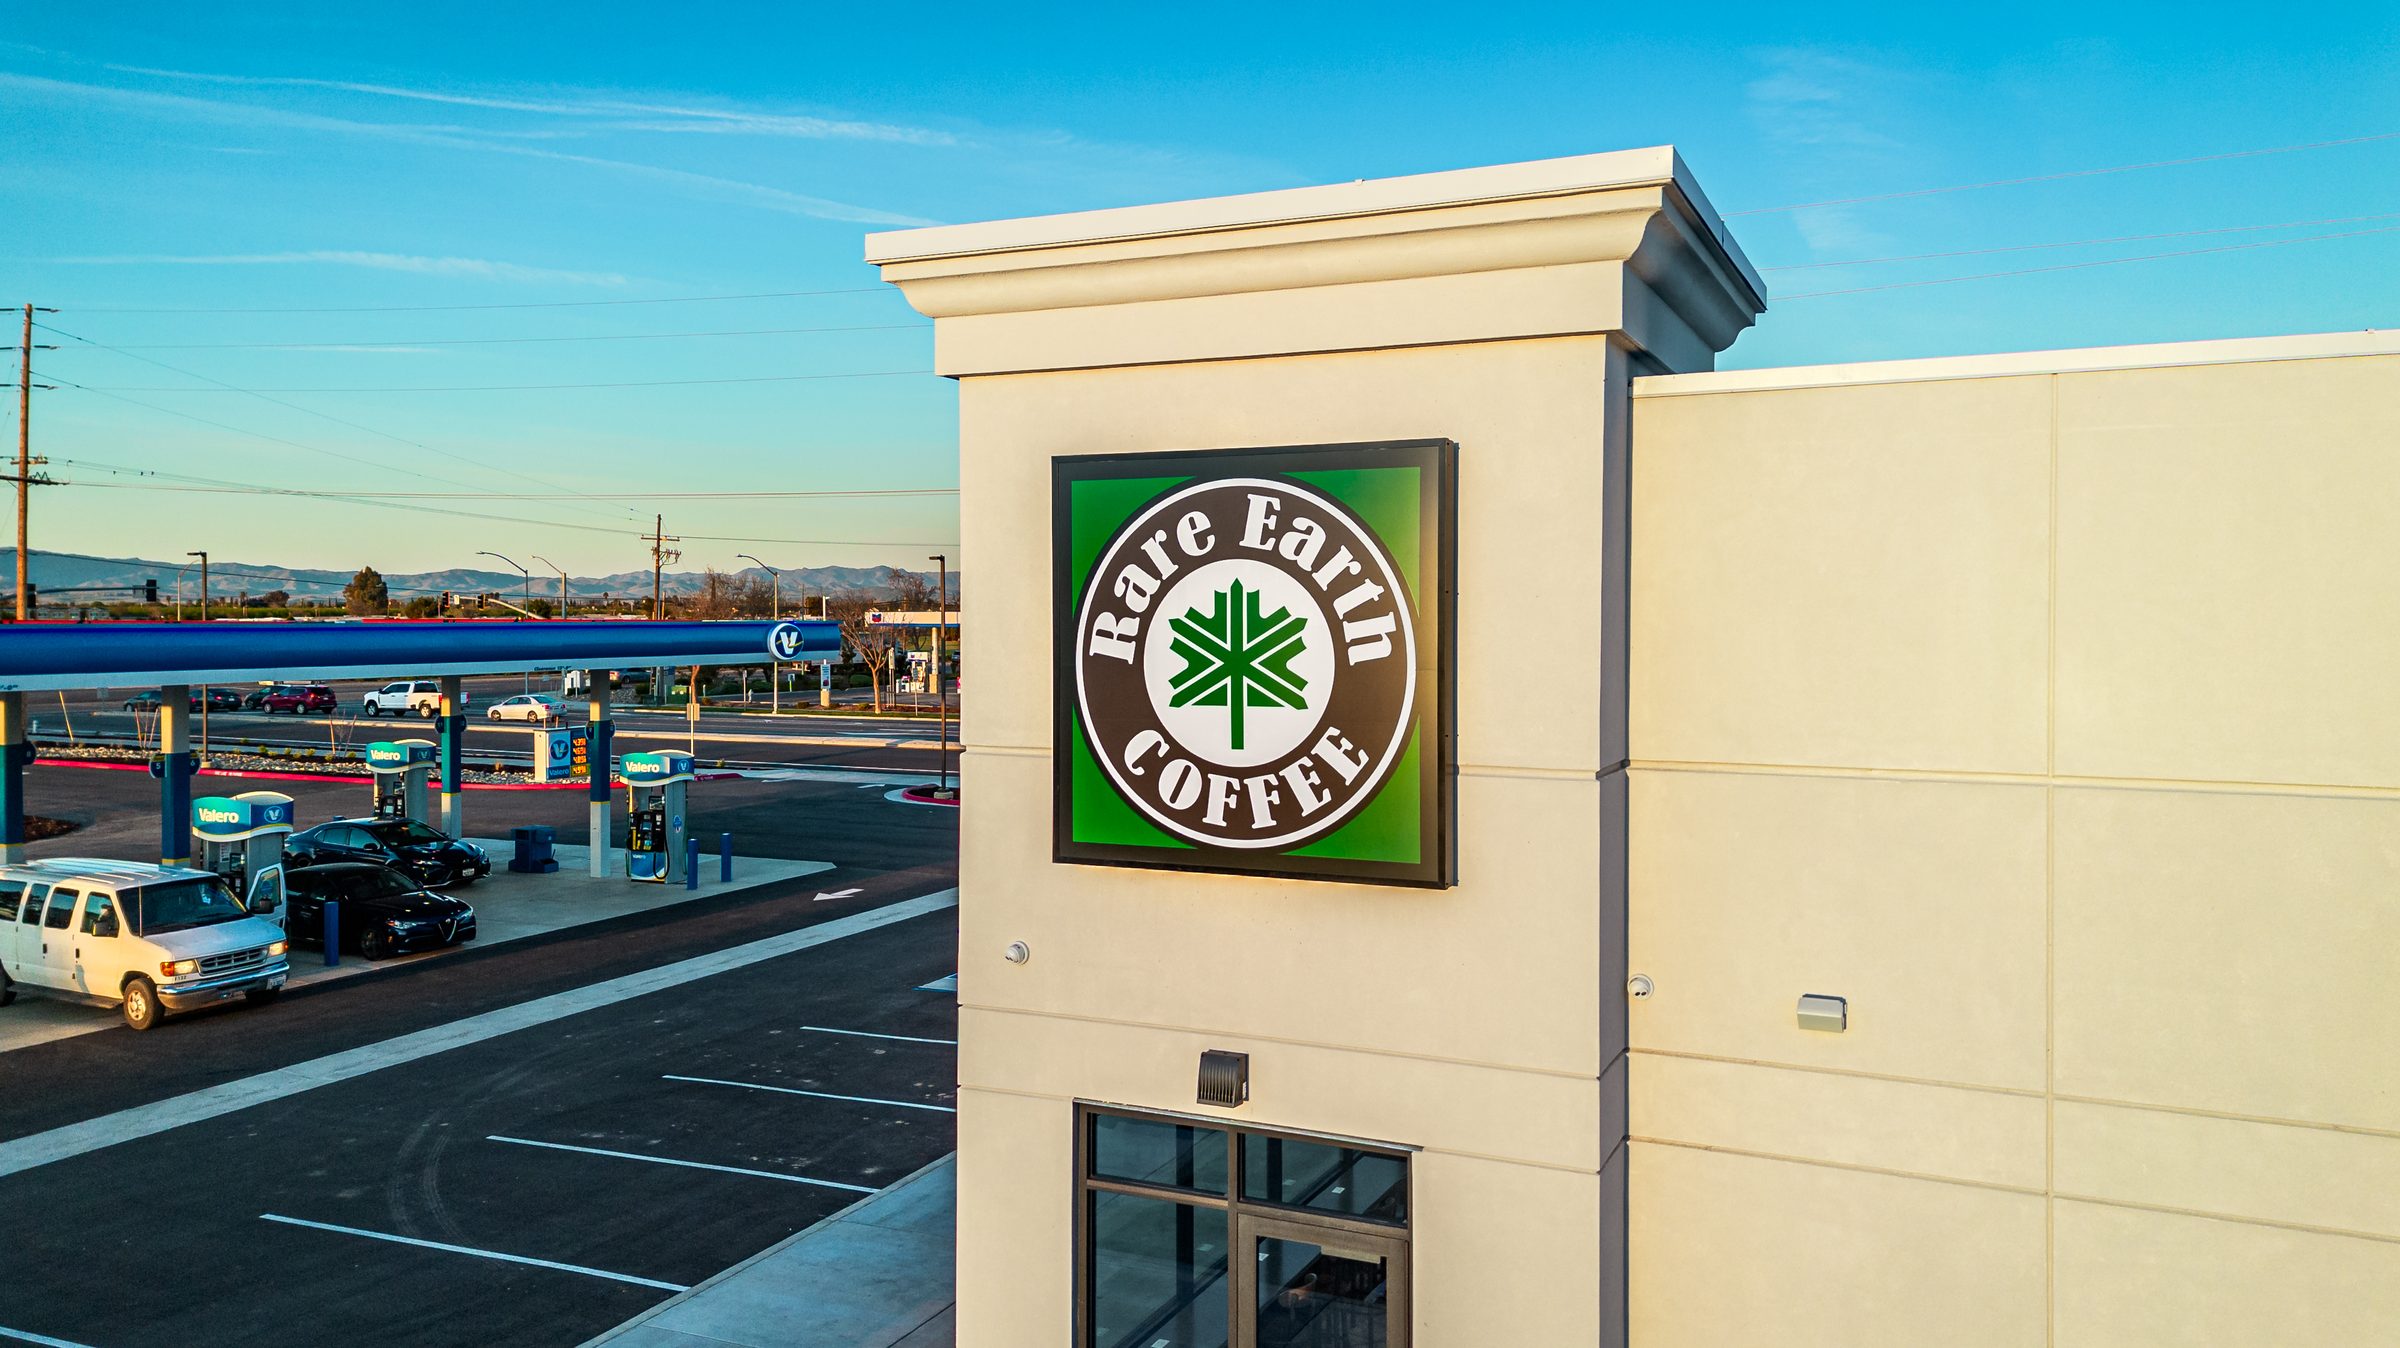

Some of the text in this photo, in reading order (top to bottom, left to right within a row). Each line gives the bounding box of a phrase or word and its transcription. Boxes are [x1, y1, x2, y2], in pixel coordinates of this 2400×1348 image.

[1089, 493, 1397, 666] Rare Earth
[370, 749, 401, 761] Valero
[549, 767, 570, 776] Valero
[625, 761, 660, 773] Valero
[1124, 726, 1369, 829] COFFEE
[198, 807, 240, 824] Valero
